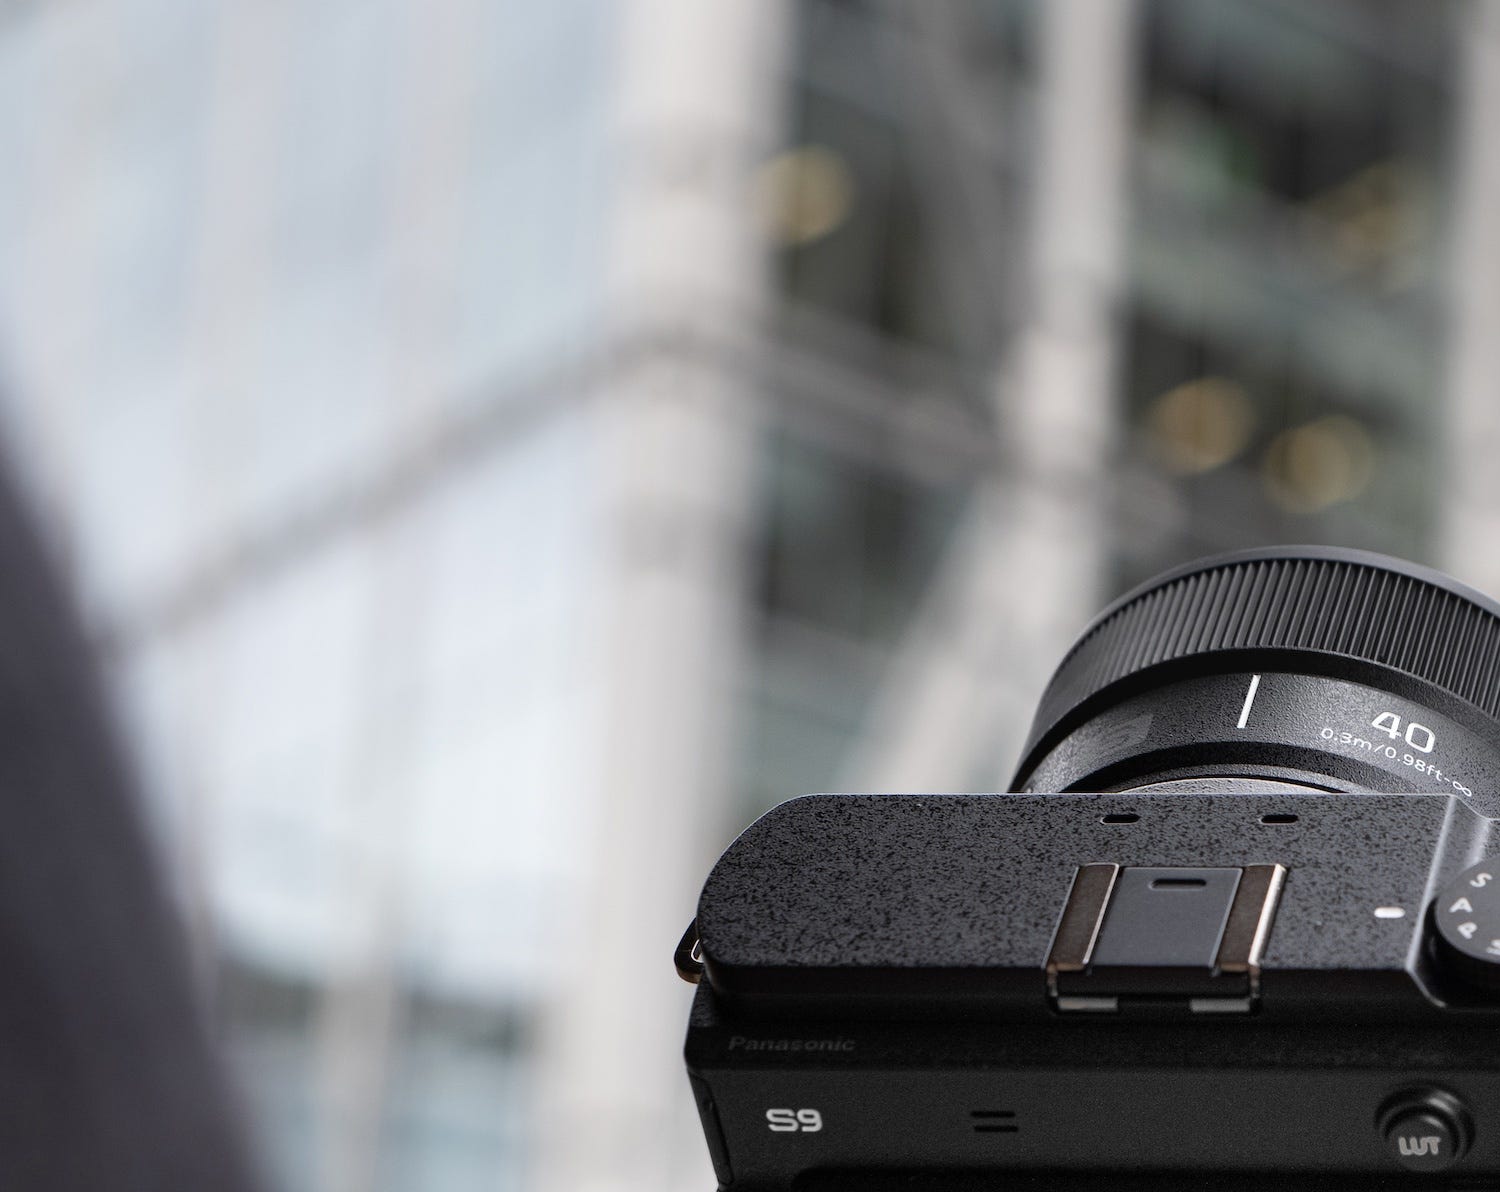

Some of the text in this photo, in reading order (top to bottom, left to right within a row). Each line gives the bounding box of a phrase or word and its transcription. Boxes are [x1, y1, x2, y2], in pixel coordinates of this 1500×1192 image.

[1371, 711, 1436, 753] 40
[1470, 873, 1493, 888] S
[1449, 897, 1473, 913] A
[1457, 922, 1478, 940] P
[728, 1036, 857, 1052] Panasonic
[766, 1108, 823, 1132] S9
[1398, 1136, 1442, 1156] LUT
